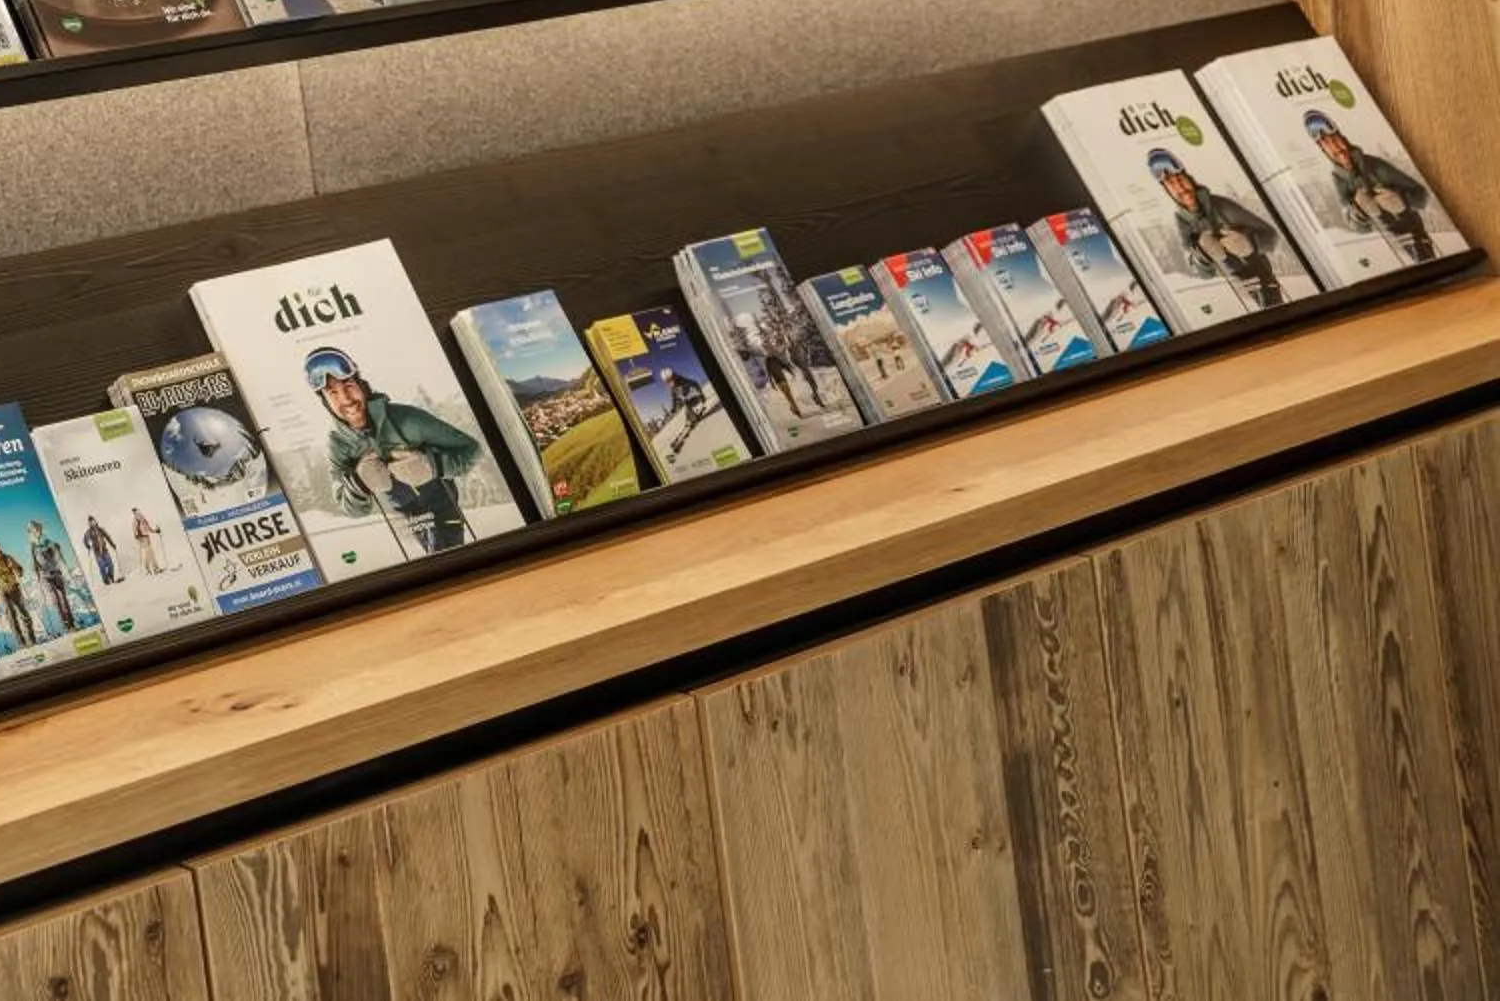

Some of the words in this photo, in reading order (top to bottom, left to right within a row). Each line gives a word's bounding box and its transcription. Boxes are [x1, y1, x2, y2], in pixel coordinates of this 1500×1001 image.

[1275, 64, 1330, 100] dich
[1119, 100, 1177, 137] dich
[274, 282, 363, 334] dich
[63, 458, 122, 482] Skitouren
[247, 552, 302, 580] VERKAUF
